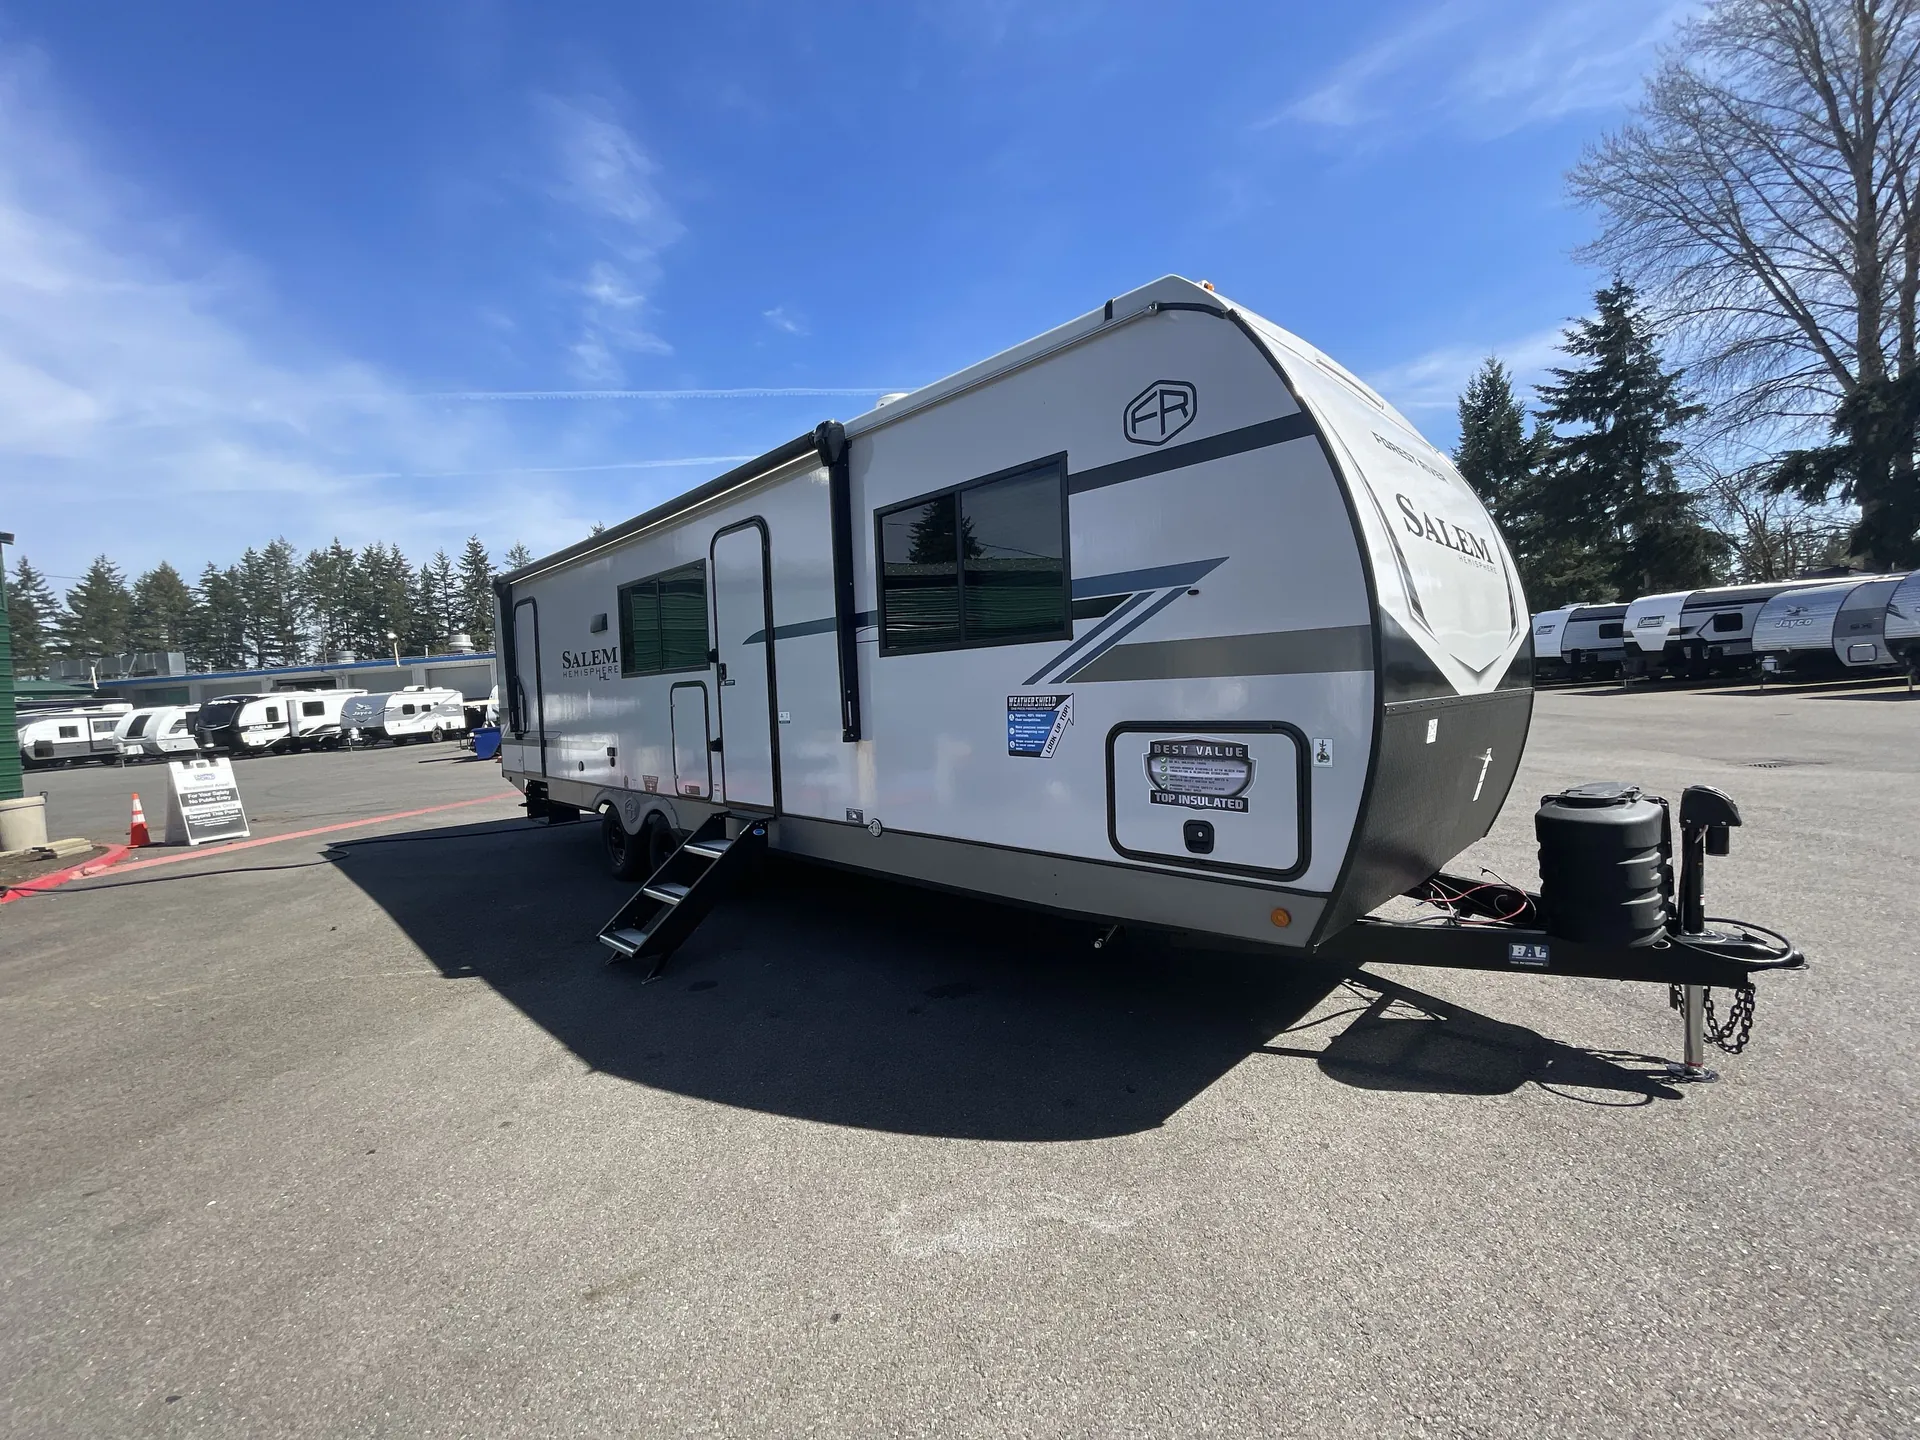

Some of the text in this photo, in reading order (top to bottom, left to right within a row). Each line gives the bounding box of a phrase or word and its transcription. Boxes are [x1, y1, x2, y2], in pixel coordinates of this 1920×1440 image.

[1130, 388, 1189, 437] FR
[1370, 430, 1450, 485] FOREST RIVER
[1395, 492, 1495, 565] SALEM
[1458, 555, 1498, 575] HEMISPHERE
[1775, 618, 1813, 629] Jayco
[562, 646, 618, 670] SALEM
[562, 665, 619, 678] HEMISPHERE
[1045, 704, 1071, 754] LOOK UP TOP!
[1154, 743, 1244, 757] BEST VALUE
[1155, 792, 1244, 810] TOP INSULATED
